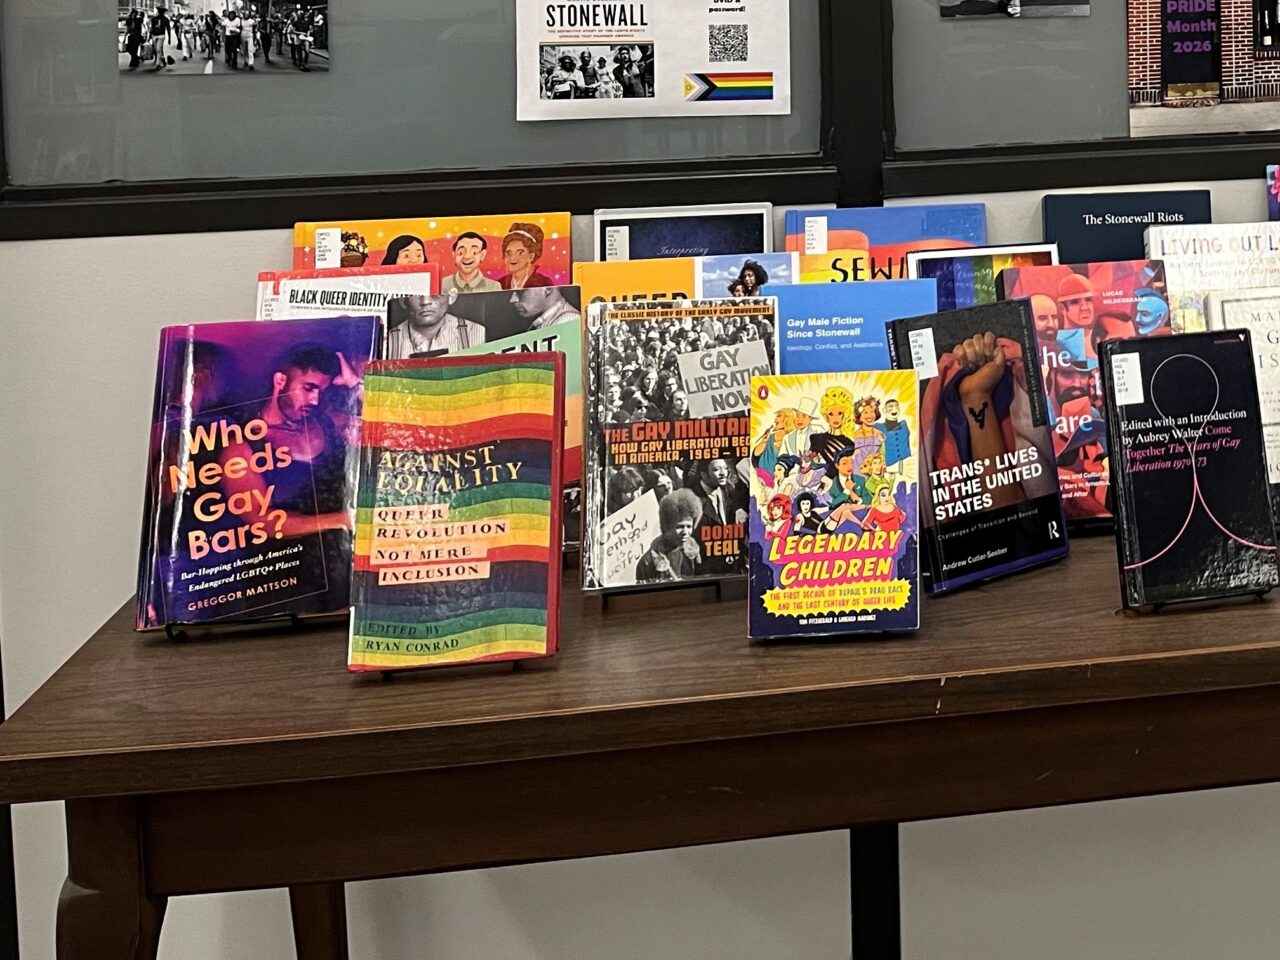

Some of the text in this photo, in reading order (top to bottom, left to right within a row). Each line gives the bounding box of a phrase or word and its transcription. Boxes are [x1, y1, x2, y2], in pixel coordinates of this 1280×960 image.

[546, 4, 648, 27] STONEWALL
[1167, 0, 1216, 13] PRIDE
[1167, 20, 1216, 33] Month
[1173, 41, 1212, 53] 2026
[1083, 211, 1184, 224] The Stonewall Riots
[289, 289, 388, 306] BLACK QUEER IDENTITY
[786, 315, 864, 328] Gay Male Fiction
[787, 327, 860, 339] Since Stonewall
[184, 419, 268, 455] Who
[611, 437, 728, 453] HOW GAY LIBERATION
[1122, 424, 1232, 447] by Aubrey Walter Come
[169, 442, 292, 493] Needs
[378, 446, 495, 472] AGAINST
[377, 462, 523, 495] EQUALITY
[194, 485, 275, 522] Gay
[935, 493, 993, 520] STATES
[188, 510, 287, 560] Bars?
[377, 523, 506, 539] REVOLUTION
[705, 540, 740, 557] TEAL
[769, 530, 903, 561] LEGENDARY
[780, 556, 893, 586] CHILDREN
[188, 577, 297, 611] GREGGOR MATTSON
[778, 595, 896, 610] AND THE LAST CENTURY OF QUEER LIFE
[366, 639, 459, 652] RYAN CONRAD
